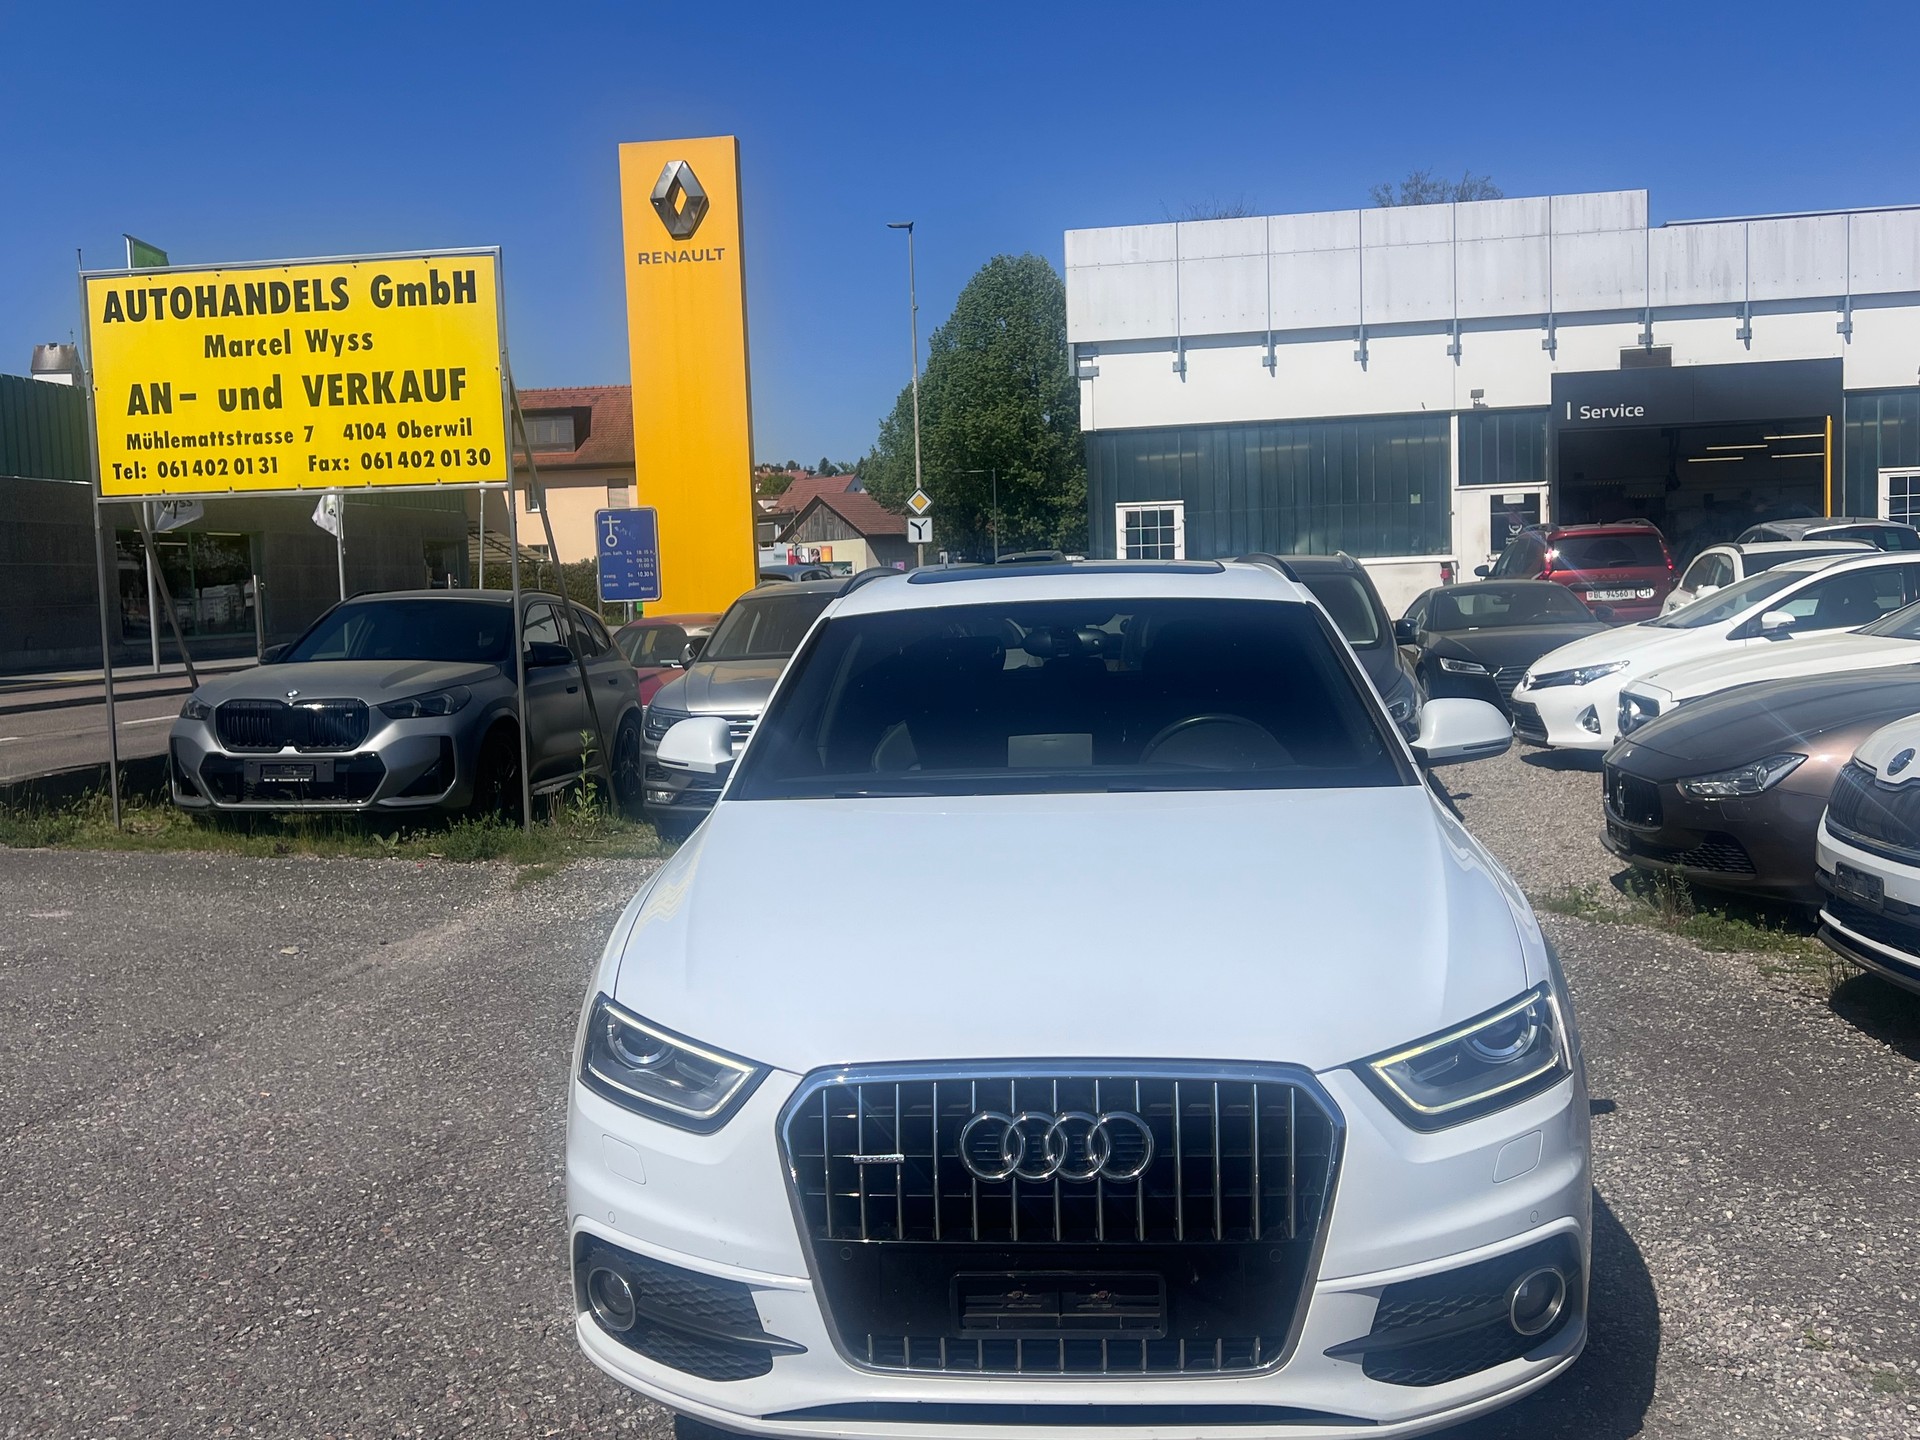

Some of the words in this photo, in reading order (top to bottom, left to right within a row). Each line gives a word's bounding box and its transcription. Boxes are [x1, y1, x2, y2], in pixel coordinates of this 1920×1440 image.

[638, 248, 726, 265] RENAULT
[103, 277, 350, 324] AUTOHANDELS
[370, 269, 477, 309] GmbH
[204, 328, 292, 358] Marcel
[305, 328, 374, 358] Wyss
[218, 374, 283, 412] und
[301, 367, 467, 407] VERKAUF
[1579, 403, 1645, 420] Service
[126, 430, 294, 451] Mühlemattstrasse
[303, 425, 314, 443] 7
[343, 422, 387, 441] 4104
[397, 417, 473, 439] Oberwil
[112, 461, 147, 480] Tel:
[308, 454, 350, 472] Fax:
[1639, 588, 1651, 597] CH
